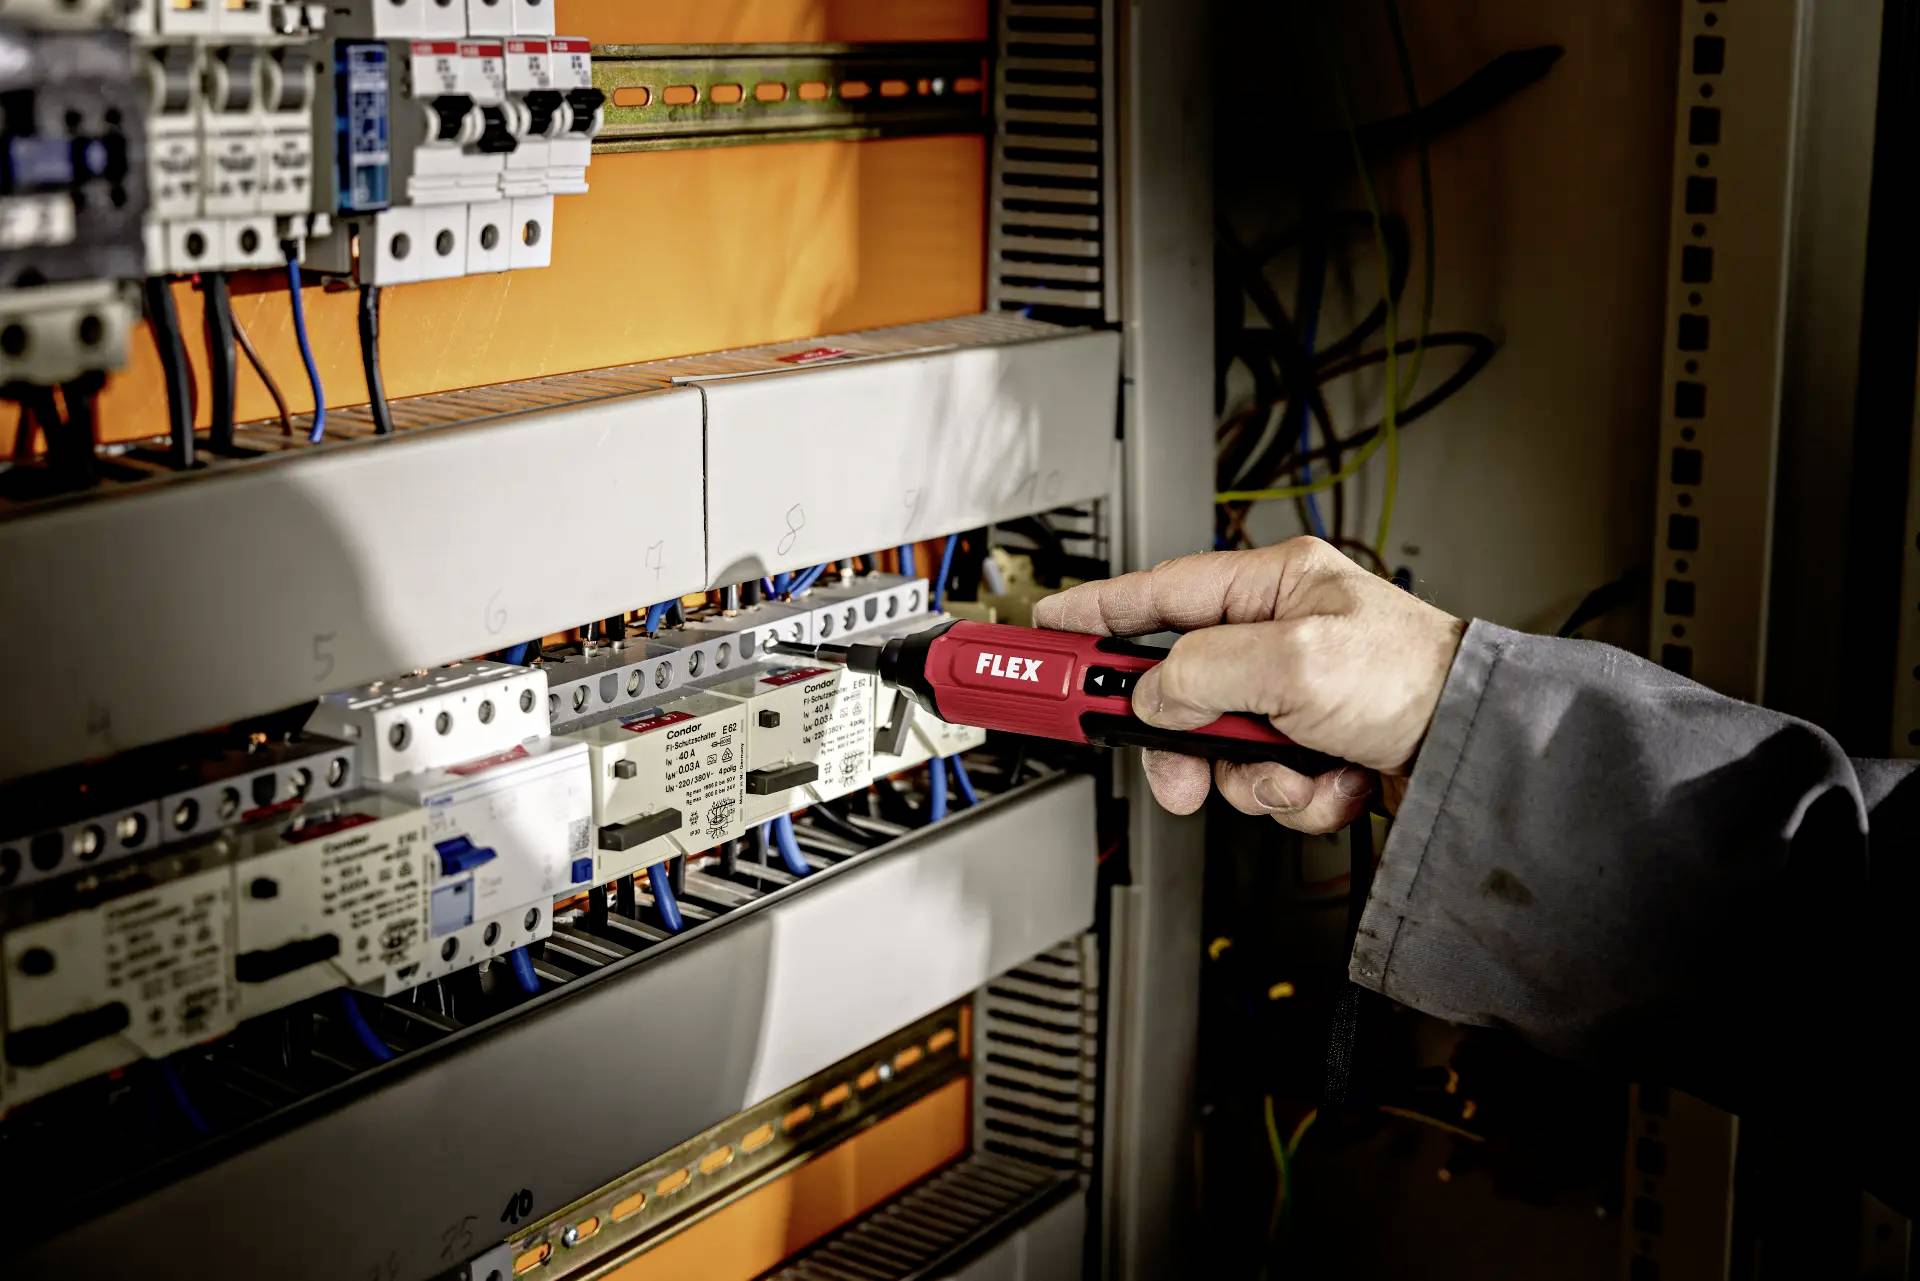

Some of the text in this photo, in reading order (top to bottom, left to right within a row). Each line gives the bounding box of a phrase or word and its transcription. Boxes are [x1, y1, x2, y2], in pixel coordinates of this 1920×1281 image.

[778, 503, 805, 556] 8
[485, 588, 507, 635] 6
[312, 631, 340, 683] 5
[975, 652, 1044, 682] FLEX
[804, 679, 836, 694] Condor
[666, 722, 702, 740] Condor
[690, 749, 696, 758] A
[501, 1188, 534, 1225] 10
